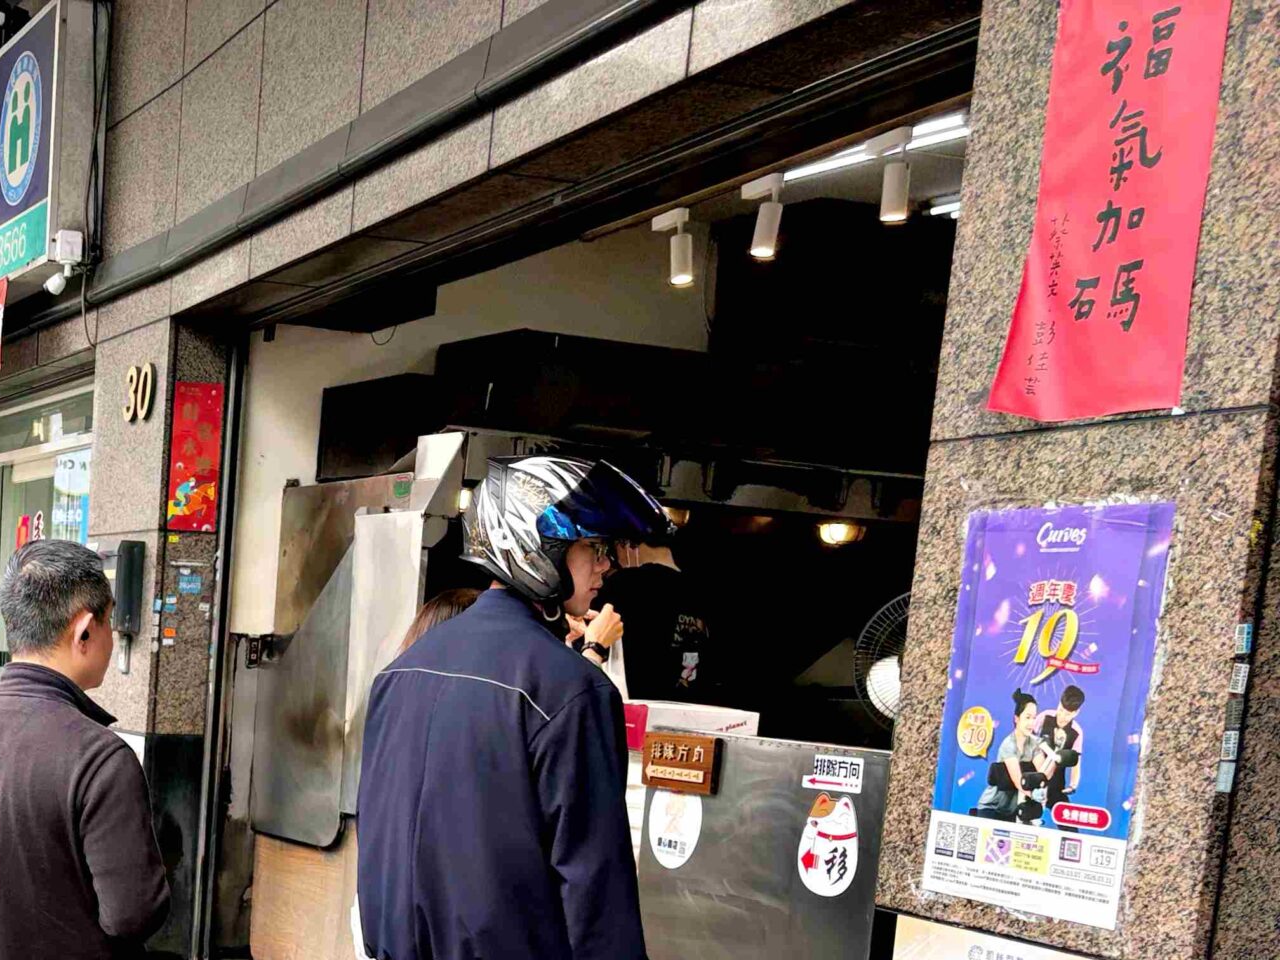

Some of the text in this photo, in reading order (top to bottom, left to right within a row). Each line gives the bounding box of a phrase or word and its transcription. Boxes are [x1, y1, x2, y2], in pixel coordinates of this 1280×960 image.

[1068, 7, 1181, 332] 福氣加碼
[123, 362, 157, 422] 30
[1036, 522, 1087, 546] Curves
[1029, 579, 1078, 606] 週年慶
[651, 741, 705, 763] 排隊方向
[814, 758, 861, 780] 排隊方向
[824, 846, 849, 886] 移
